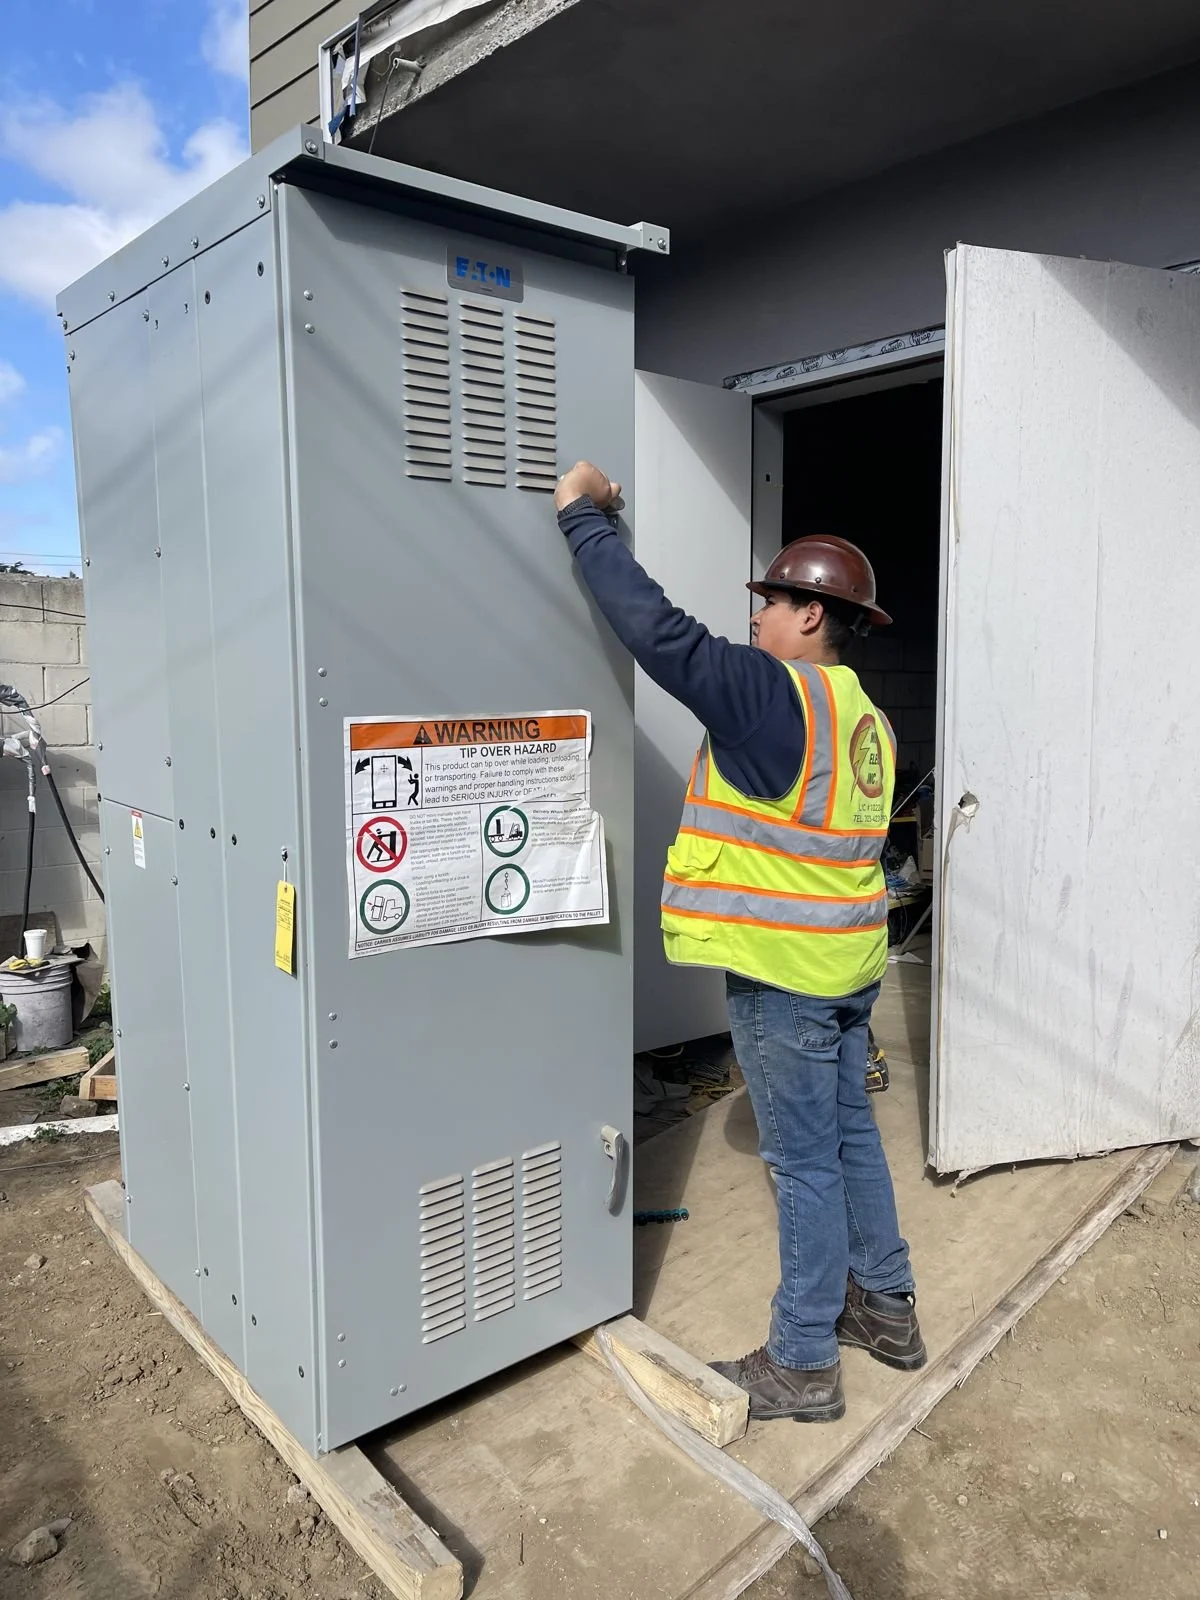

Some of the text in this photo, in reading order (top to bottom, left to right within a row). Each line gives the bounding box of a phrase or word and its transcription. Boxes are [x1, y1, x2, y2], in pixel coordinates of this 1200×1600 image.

[434, 720, 540, 744] WARNING
[460, 742, 557, 758] TIP OVER HAZARD
[442, 762, 469, 771] product
[552, 754, 580, 762] unloading
[434, 772, 478, 781] transporting.
[512, 768, 534, 776] comply
[425, 784, 457, 793] warnings
[474, 782, 496, 790] proper
[497, 778, 524, 787] handling
[560, 774, 576, 782] could
[450, 792, 486, 802] SERIOUS
[486, 790, 514, 798] INJURY
[392, 934, 412, 942] ASSUMES
[412, 931, 430, 939] LIABILITY
